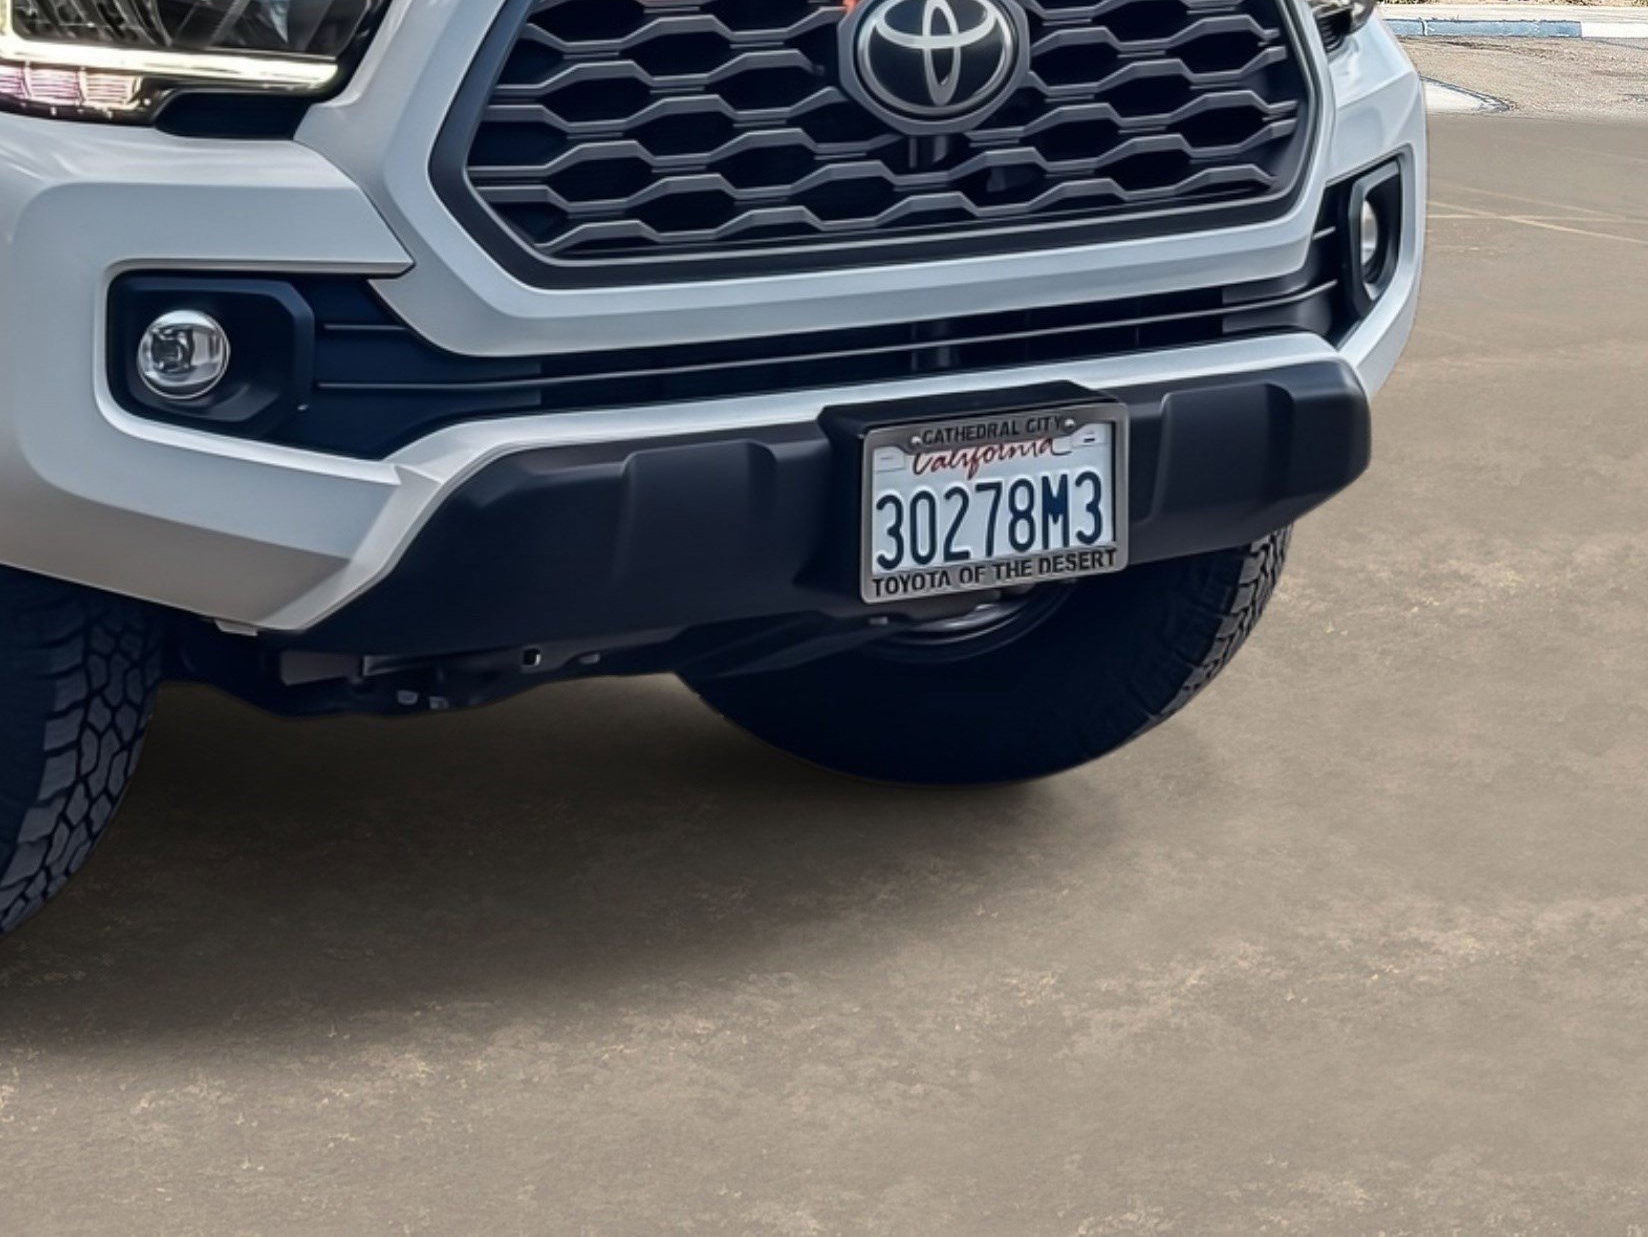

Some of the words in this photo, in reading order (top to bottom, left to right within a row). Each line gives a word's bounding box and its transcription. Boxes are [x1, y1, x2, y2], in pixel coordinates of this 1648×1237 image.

[922, 423, 1021, 446] CATHEDRAL
[1026, 415, 1064, 434] CITY
[913, 438, 1072, 479] California
[876, 471, 1103, 571] 30278M3
[873, 573, 951, 598] TOYOTA
[960, 566, 985, 584] OF
[993, 559, 1033, 580] THE
[1039, 549, 1117, 574] DESERT
